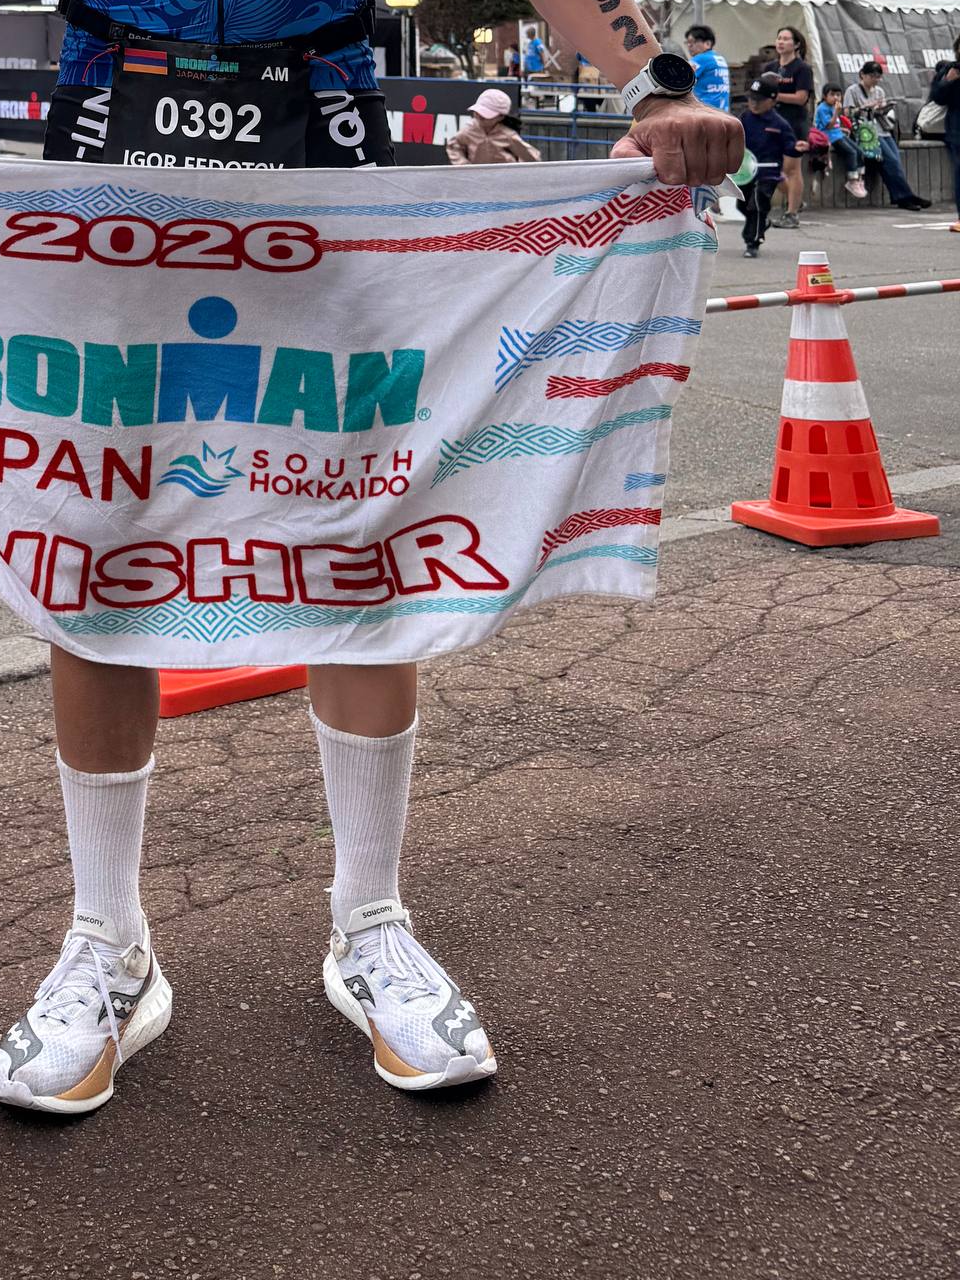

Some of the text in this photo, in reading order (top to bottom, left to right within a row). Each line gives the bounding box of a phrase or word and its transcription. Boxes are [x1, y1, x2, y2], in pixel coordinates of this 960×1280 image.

[175, 55, 240, 73] IRONMAN
[176, 70, 207, 81] JAPAN
[261, 66, 289, 82] AM
[155, 97, 262, 143] 0392
[123, 150, 176, 168] IGOR
[251, 449, 413, 479] SOUTH
[250, 472, 411, 501] HOKKAIDO
[362, 905, 393, 918] saucony
